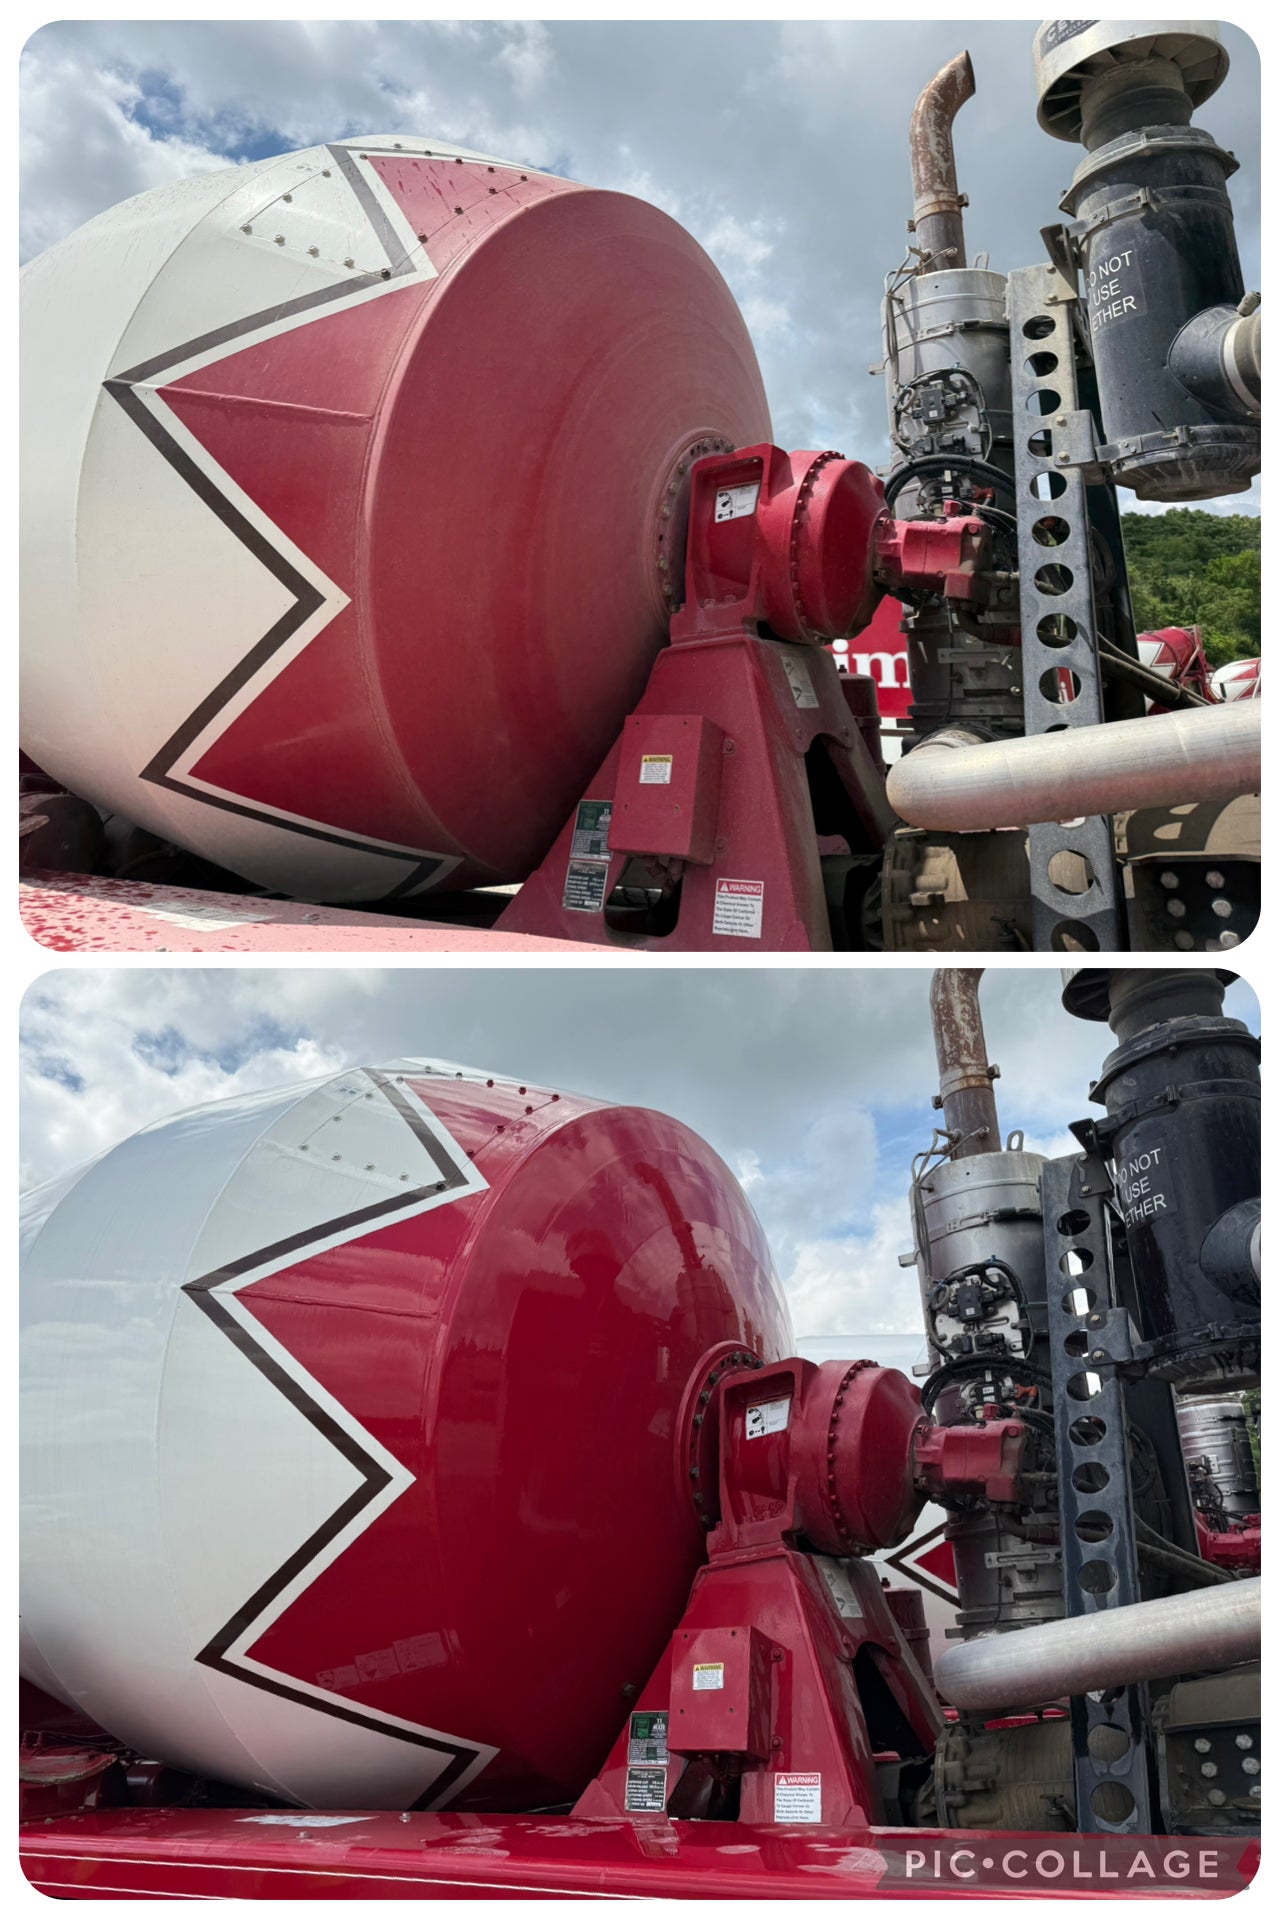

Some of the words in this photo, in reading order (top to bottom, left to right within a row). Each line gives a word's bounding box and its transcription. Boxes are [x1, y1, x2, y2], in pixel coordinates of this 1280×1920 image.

[1098, 250, 1133, 280] NOT
[1093, 278, 1121, 306] USE
[1091, 295, 1137, 332] ETHER
[729, 883, 761, 893] WARNING
[1129, 1148, 1161, 1176] NOT
[1125, 1176, 1151, 1203] USE
[1125, 1193, 1168, 1229] ETHER
[786, 1776, 818, 1784] WARNING
